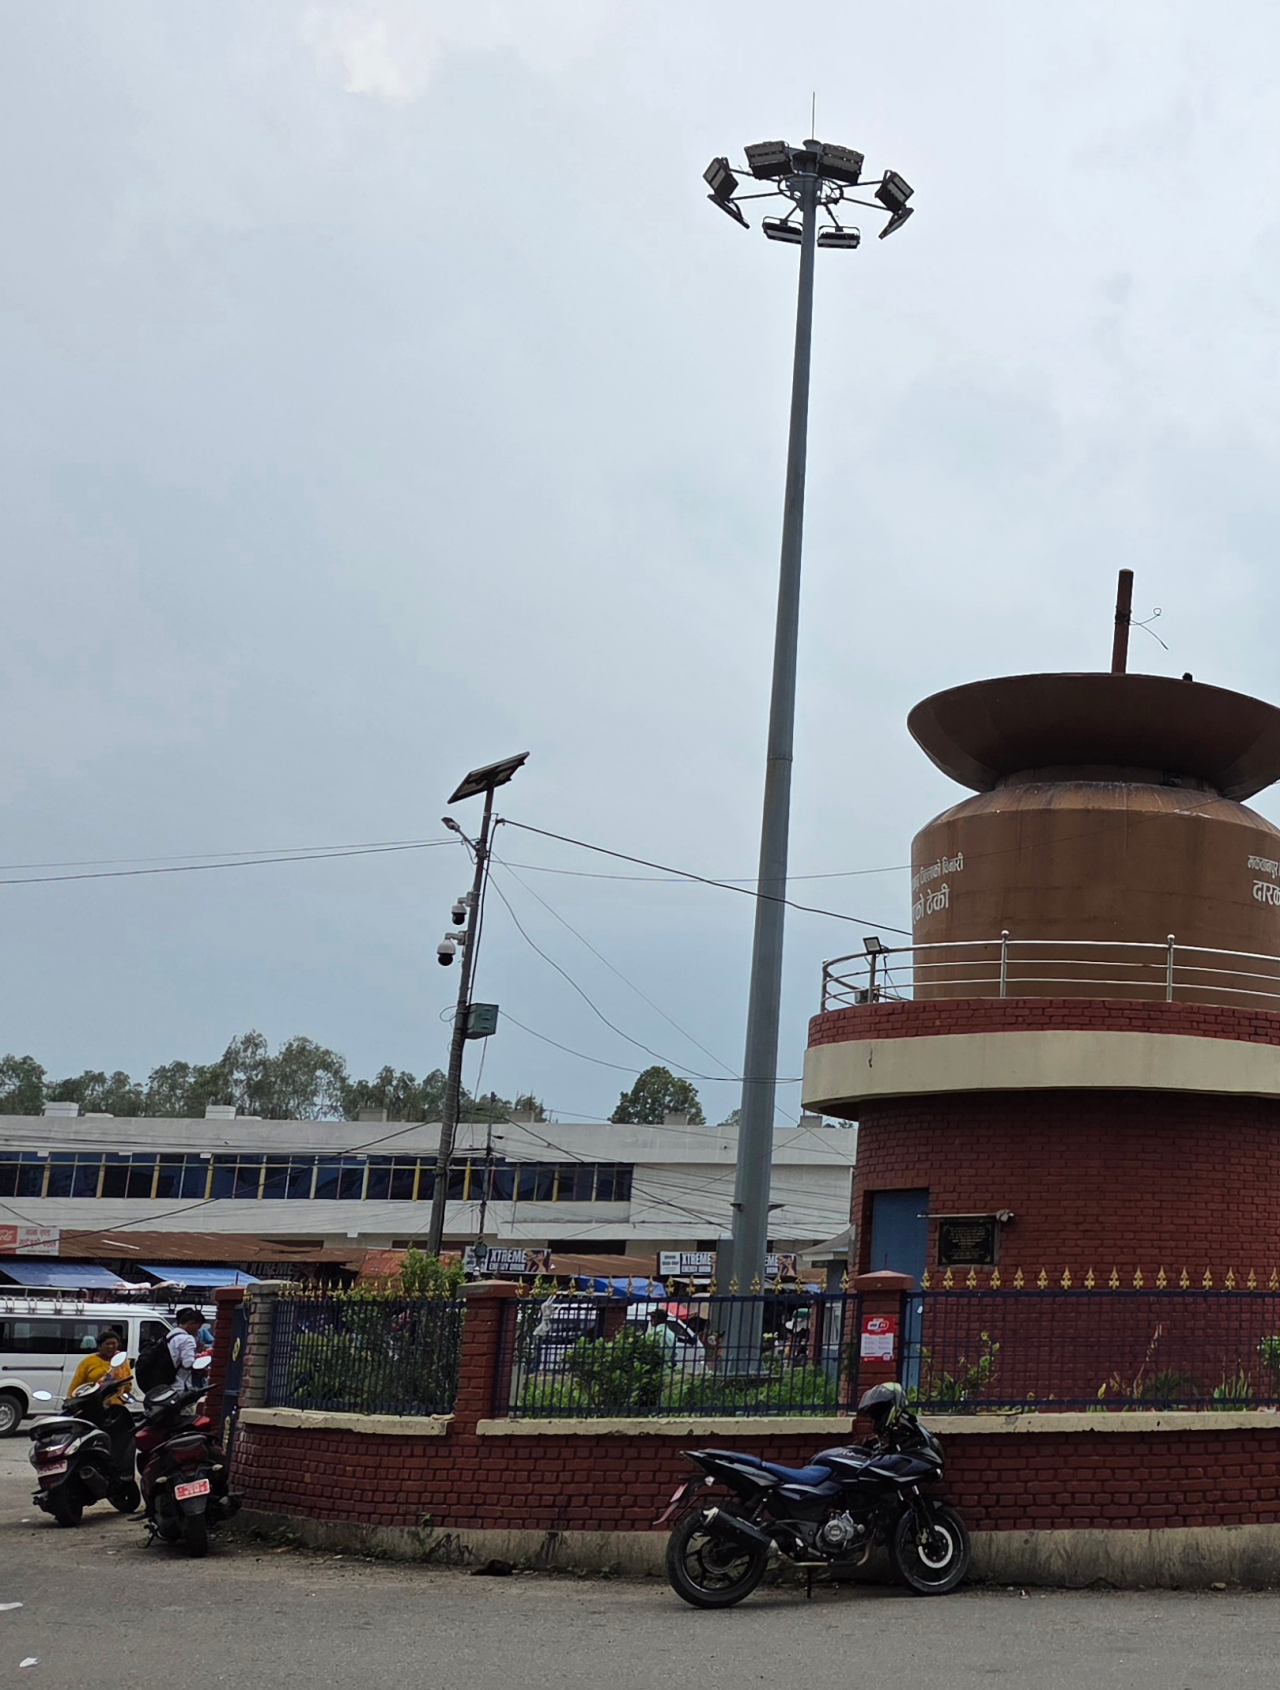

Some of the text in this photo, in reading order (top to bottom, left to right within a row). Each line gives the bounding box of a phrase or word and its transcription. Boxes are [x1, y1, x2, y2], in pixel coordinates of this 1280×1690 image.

[926, 883, 950, 914] ठेकी
[490, 1249, 526, 1263] XTREME
[682, 1253, 711, 1265] XTREME
